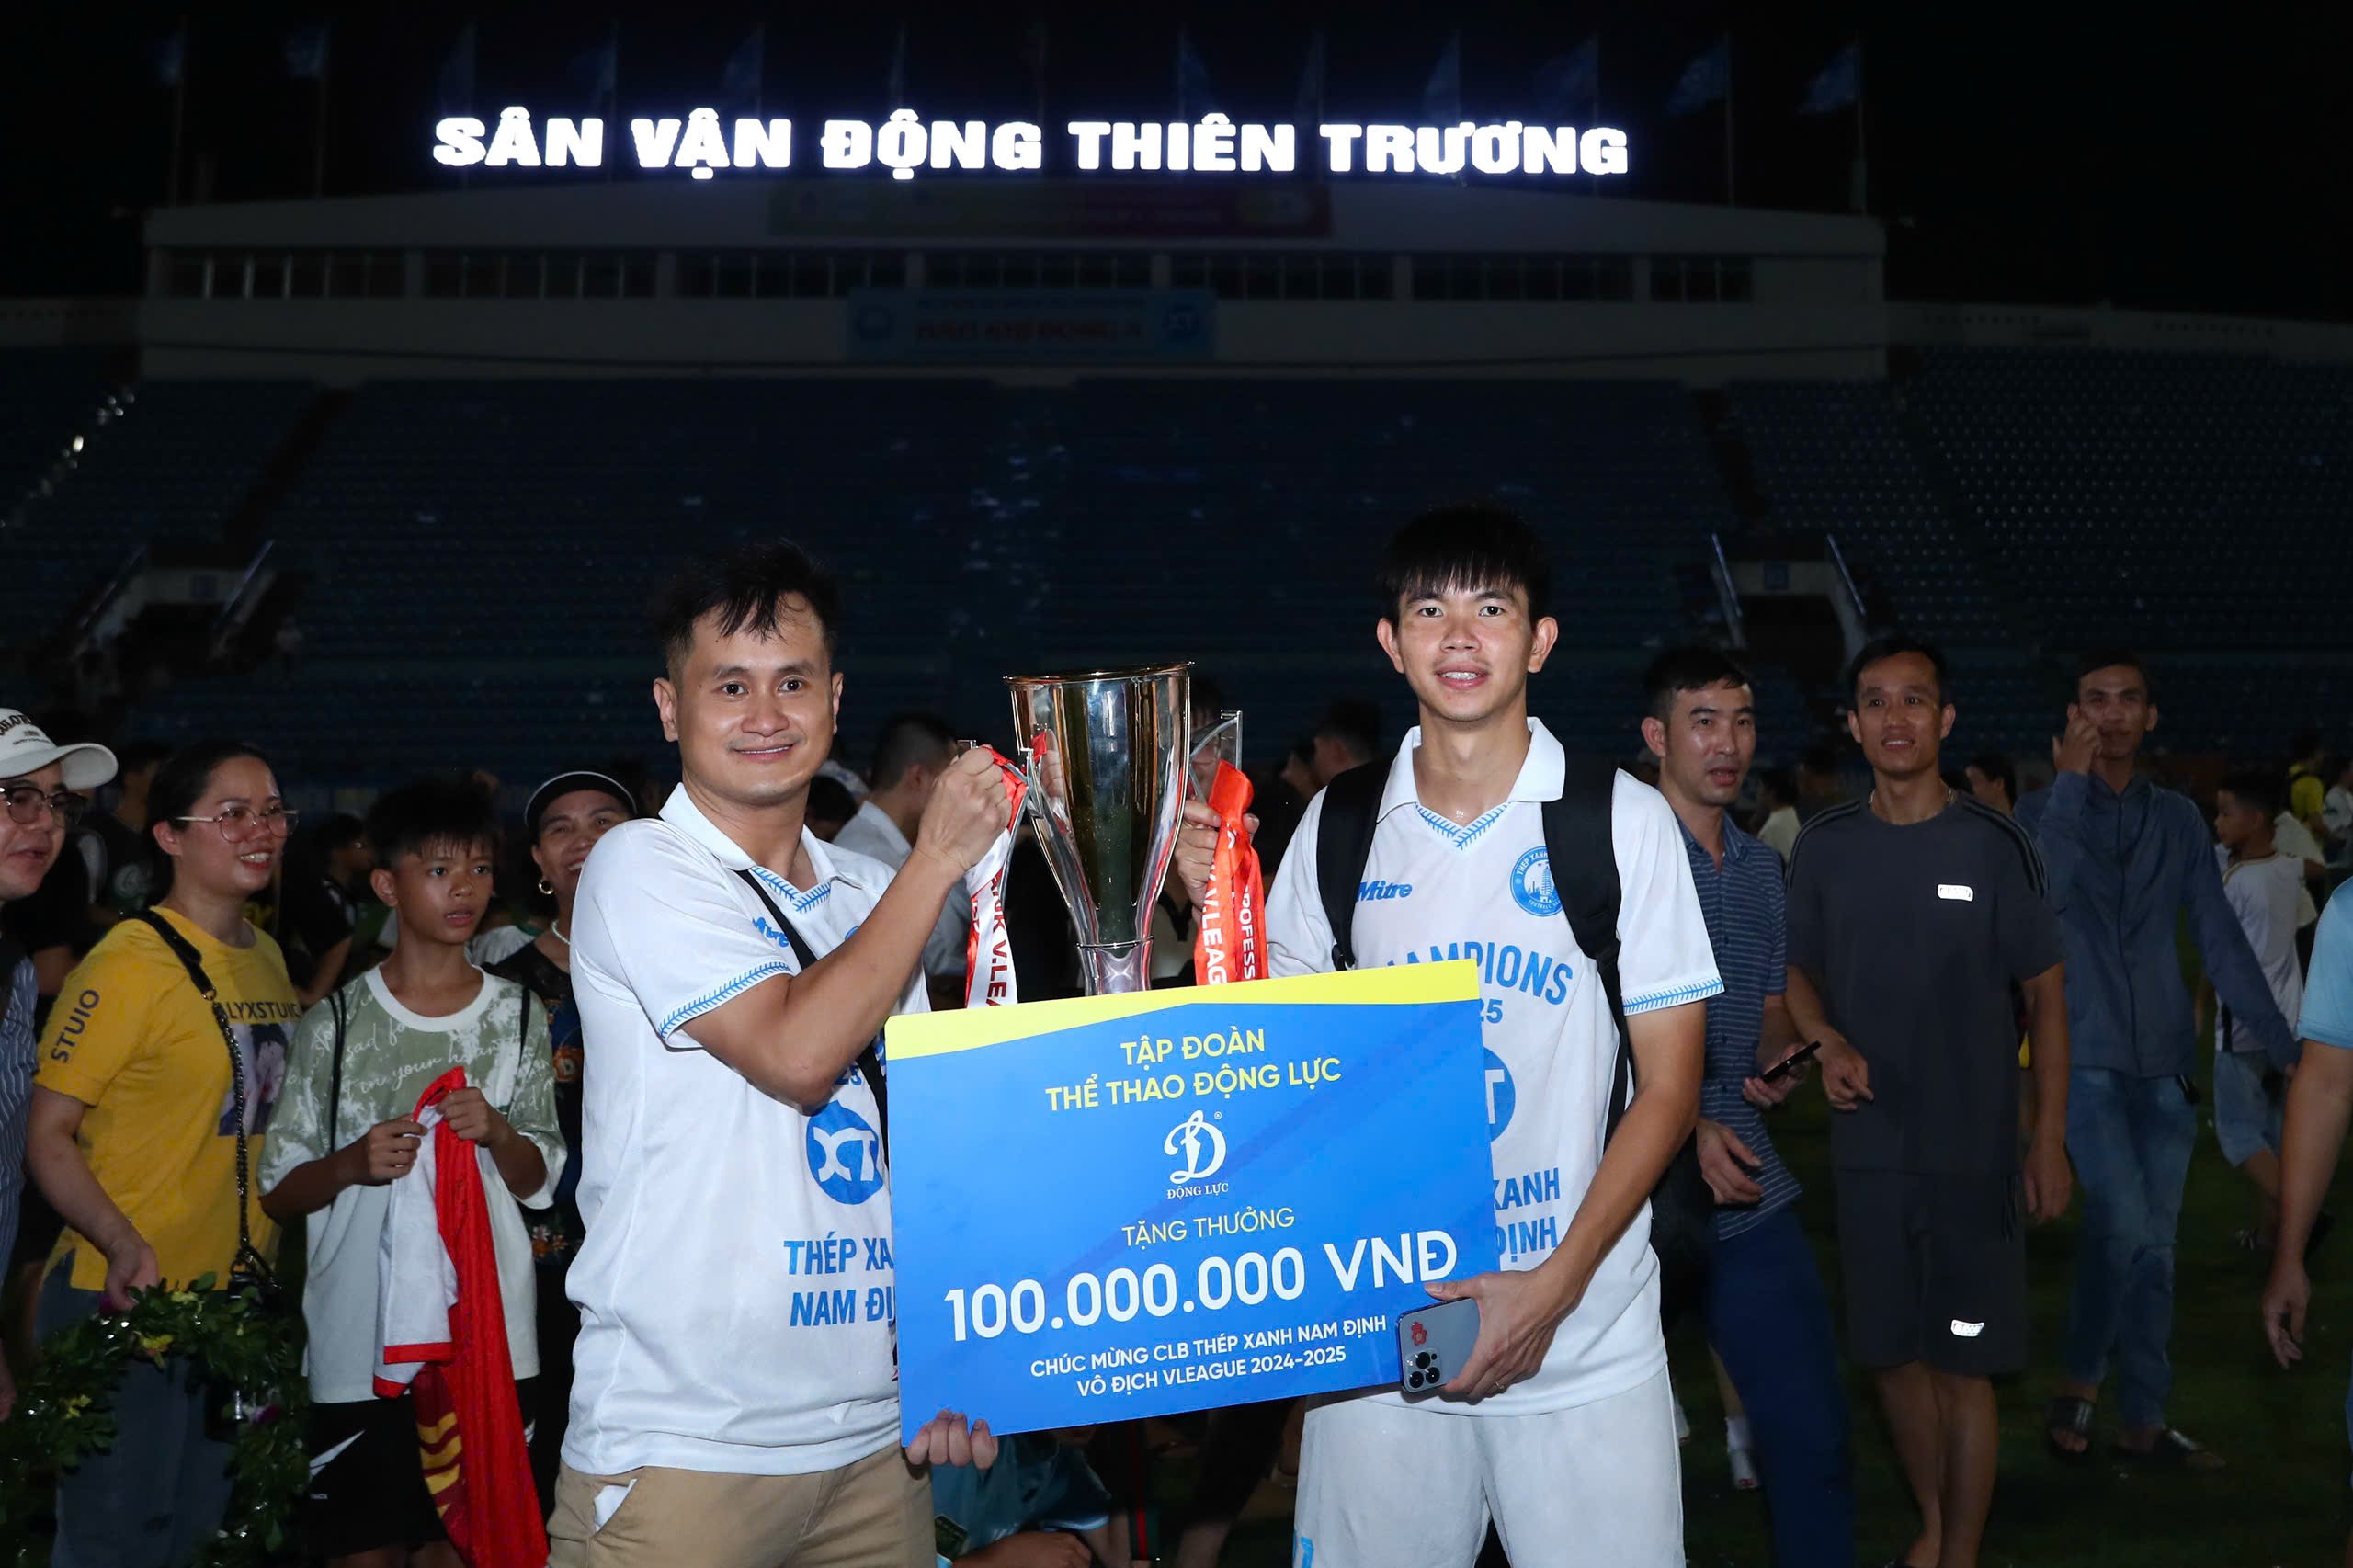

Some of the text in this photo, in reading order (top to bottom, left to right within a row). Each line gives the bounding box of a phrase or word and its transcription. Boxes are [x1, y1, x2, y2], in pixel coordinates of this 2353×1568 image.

[434, 107, 1628, 179] SÂN VẬN ĐỘNG THIÊN TRƯƠNG
[1357, 881, 1413, 901] Mitre
[1201, 887, 1228, 985] V.LEAG
[51, 989, 100, 1063] STUIO
[1120, 1026, 1266, 1071] TẬP ĐOÀN
[1045, 1057, 1342, 1111] THỂ THAO ĐỘNG LỰC
[1485, 1069, 1506, 1125] T
[1166, 1182, 1229, 1200] ĐỘNG LỰC
[783, 1231, 895, 1275] THÉP XA
[1121, 1206, 1295, 1250] TẶNG THƯỞNG
[790, 1290, 857, 1327] NAM
[944, 1230, 1458, 1342] 100.000.000 VNĐ
[1030, 1315, 1387, 1378] CHÚC MỪNG CLB THÉP XANH NAM ĐỊNH
[1077, 1346, 1347, 1397] VÔ ĐỊCH VLEAGUE 2024-2025
